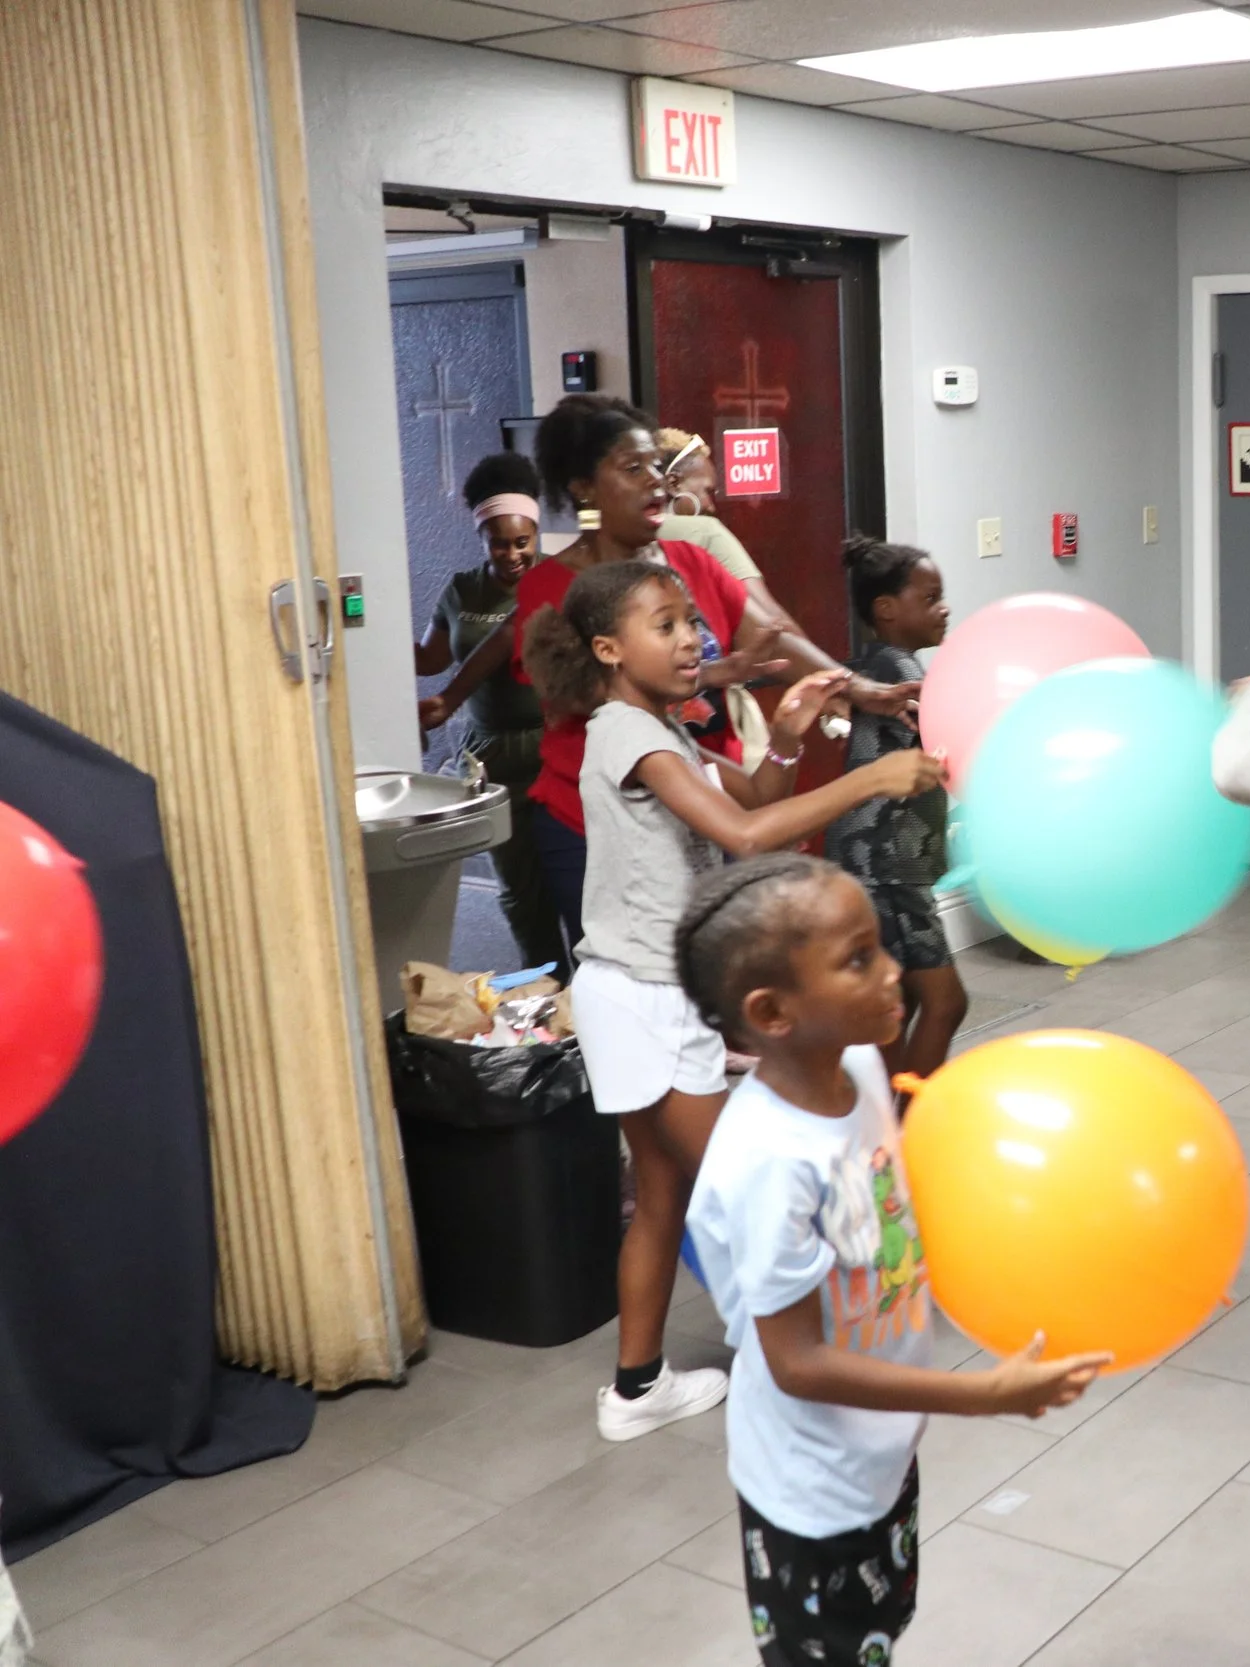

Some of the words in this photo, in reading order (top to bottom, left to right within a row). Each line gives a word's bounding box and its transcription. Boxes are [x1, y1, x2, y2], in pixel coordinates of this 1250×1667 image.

[664, 109, 722, 178] EXIT
[733, 439, 769, 458] EXIT
[730, 463, 774, 483] ONLY
